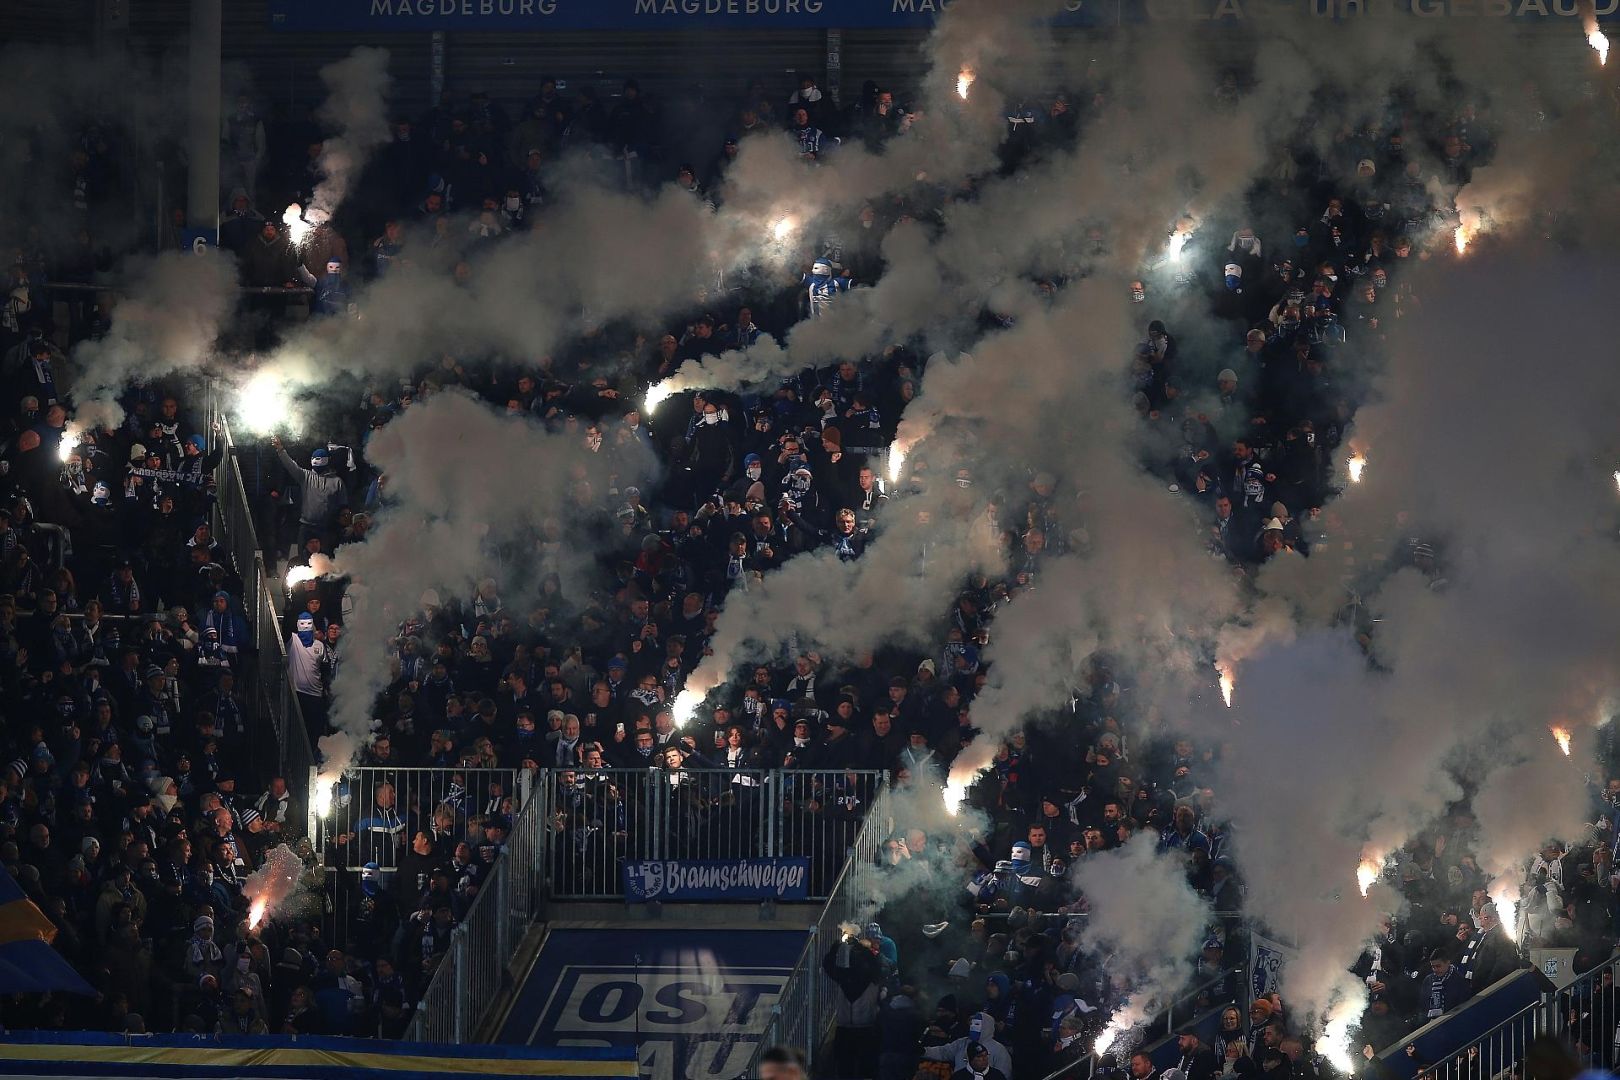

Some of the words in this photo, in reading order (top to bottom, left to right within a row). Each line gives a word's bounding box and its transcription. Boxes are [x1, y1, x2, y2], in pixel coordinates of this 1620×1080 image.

[370, 0, 558, 15] MAGDEBURG
[634, 0, 823, 14] MAGDEBURG
[193, 236, 207, 256] 6
[666, 859, 804, 895] Braunschweiger
[578, 981, 784, 1025] OST
